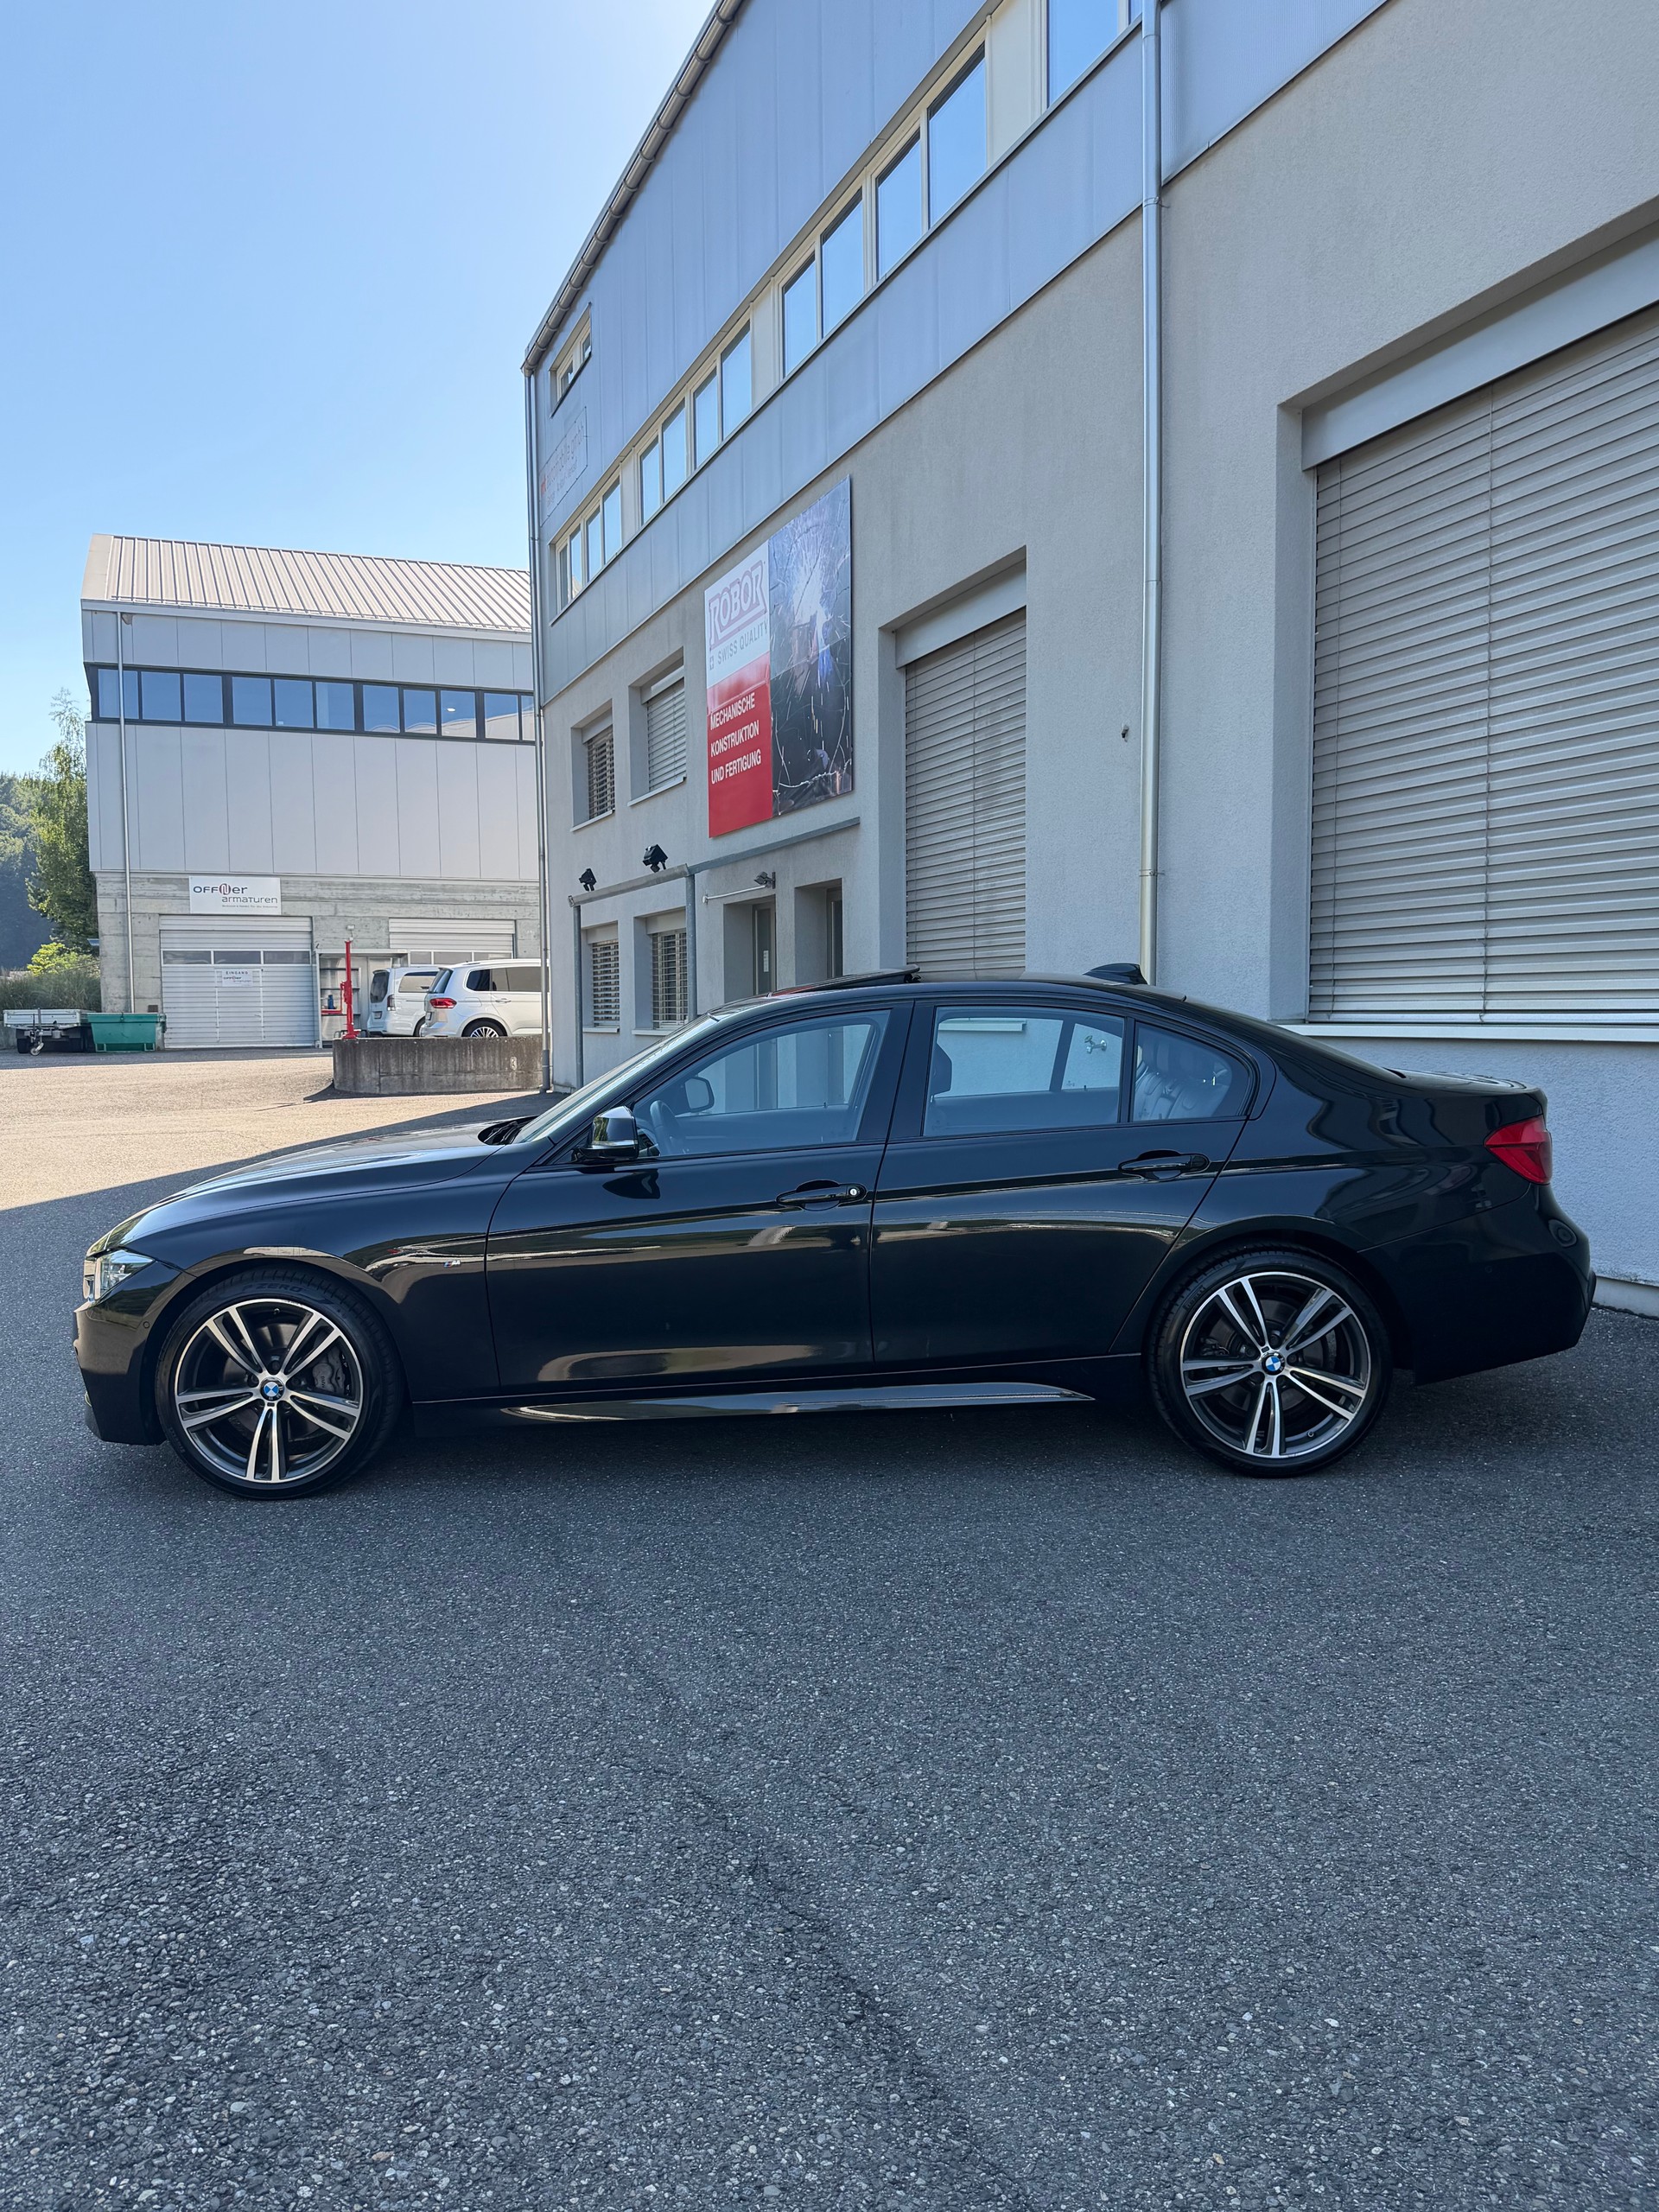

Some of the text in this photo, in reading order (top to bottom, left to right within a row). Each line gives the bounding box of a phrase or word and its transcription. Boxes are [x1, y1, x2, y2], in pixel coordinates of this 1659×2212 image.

[709, 562, 766, 650] ROBOR
[717, 618, 768, 665] SWISS QUALITY
[710, 692, 755, 731] MECHANISCHE
[710, 720, 760, 758] KONSTRUKTION
[711, 749, 761, 785] UND FERTIGUNG
